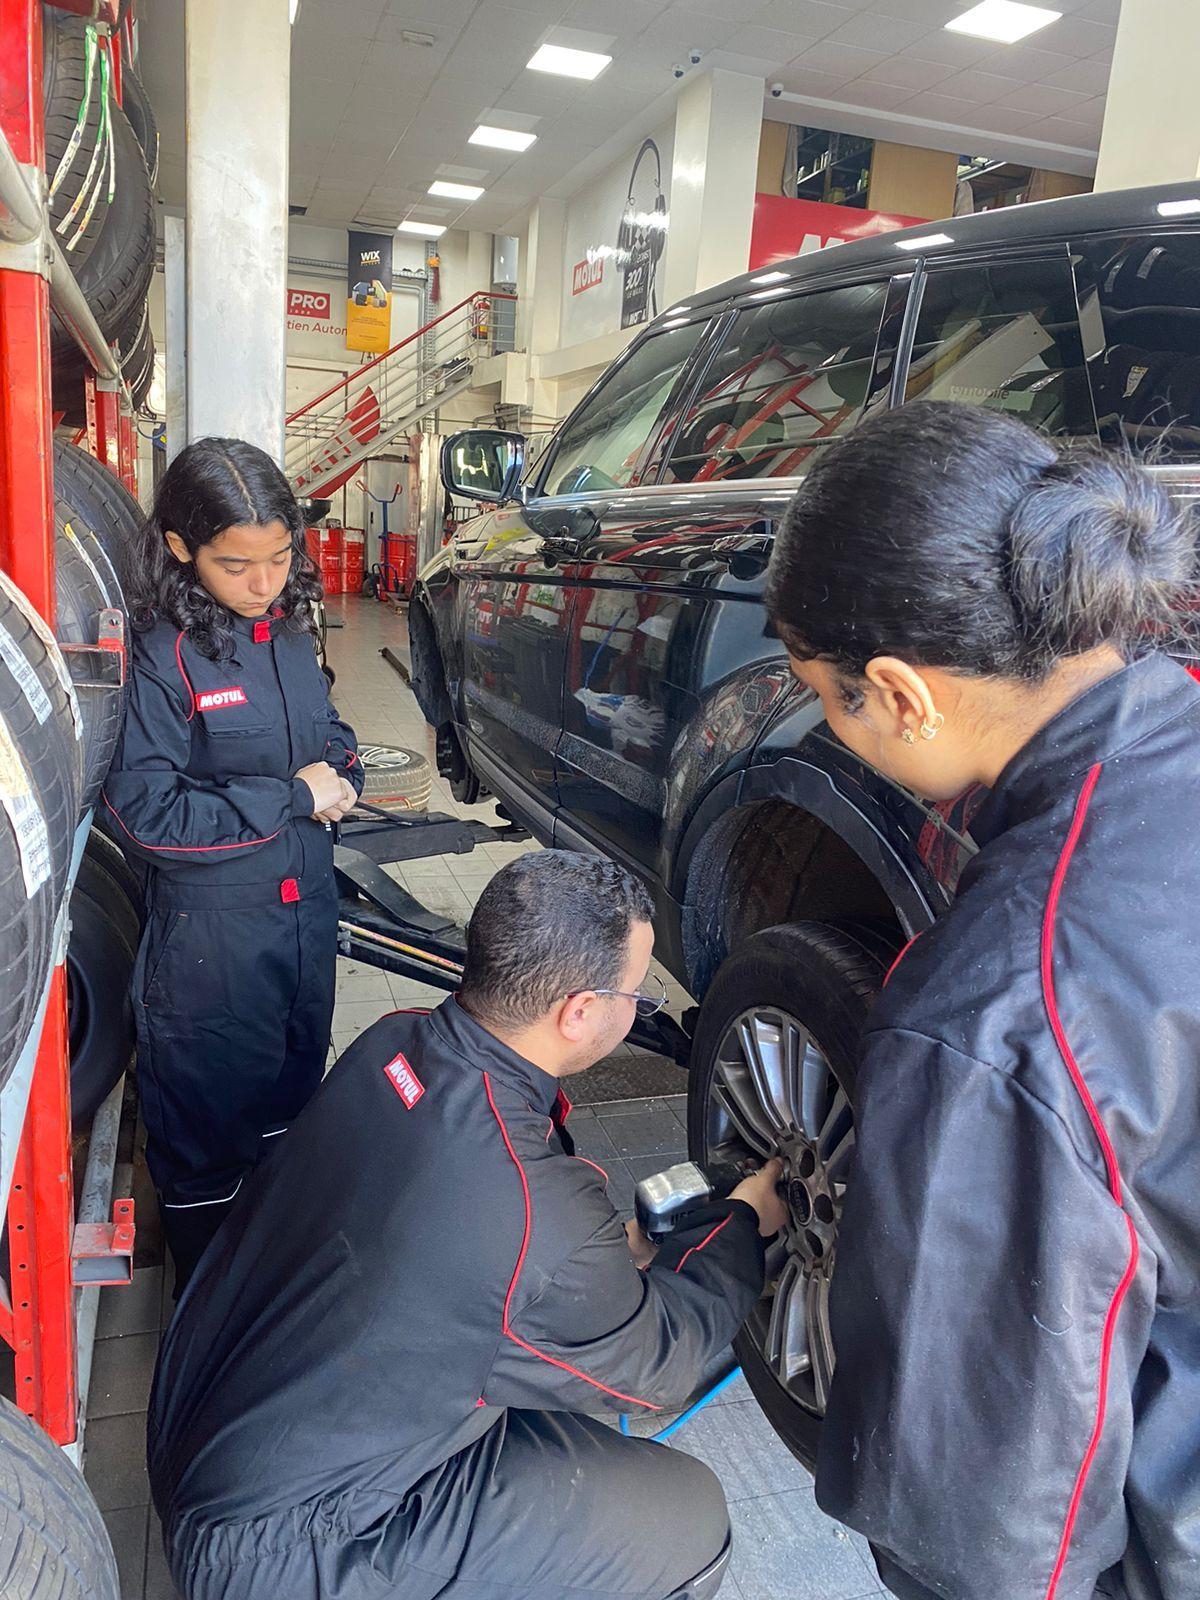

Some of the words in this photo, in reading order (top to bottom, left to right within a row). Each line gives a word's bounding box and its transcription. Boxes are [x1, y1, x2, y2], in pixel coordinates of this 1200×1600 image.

[361, 250, 380, 261] WIX
[291, 293, 327, 310] PRO
[200, 689, 245, 708] MOTUL
[389, 1060, 419, 1104] MOTUL
